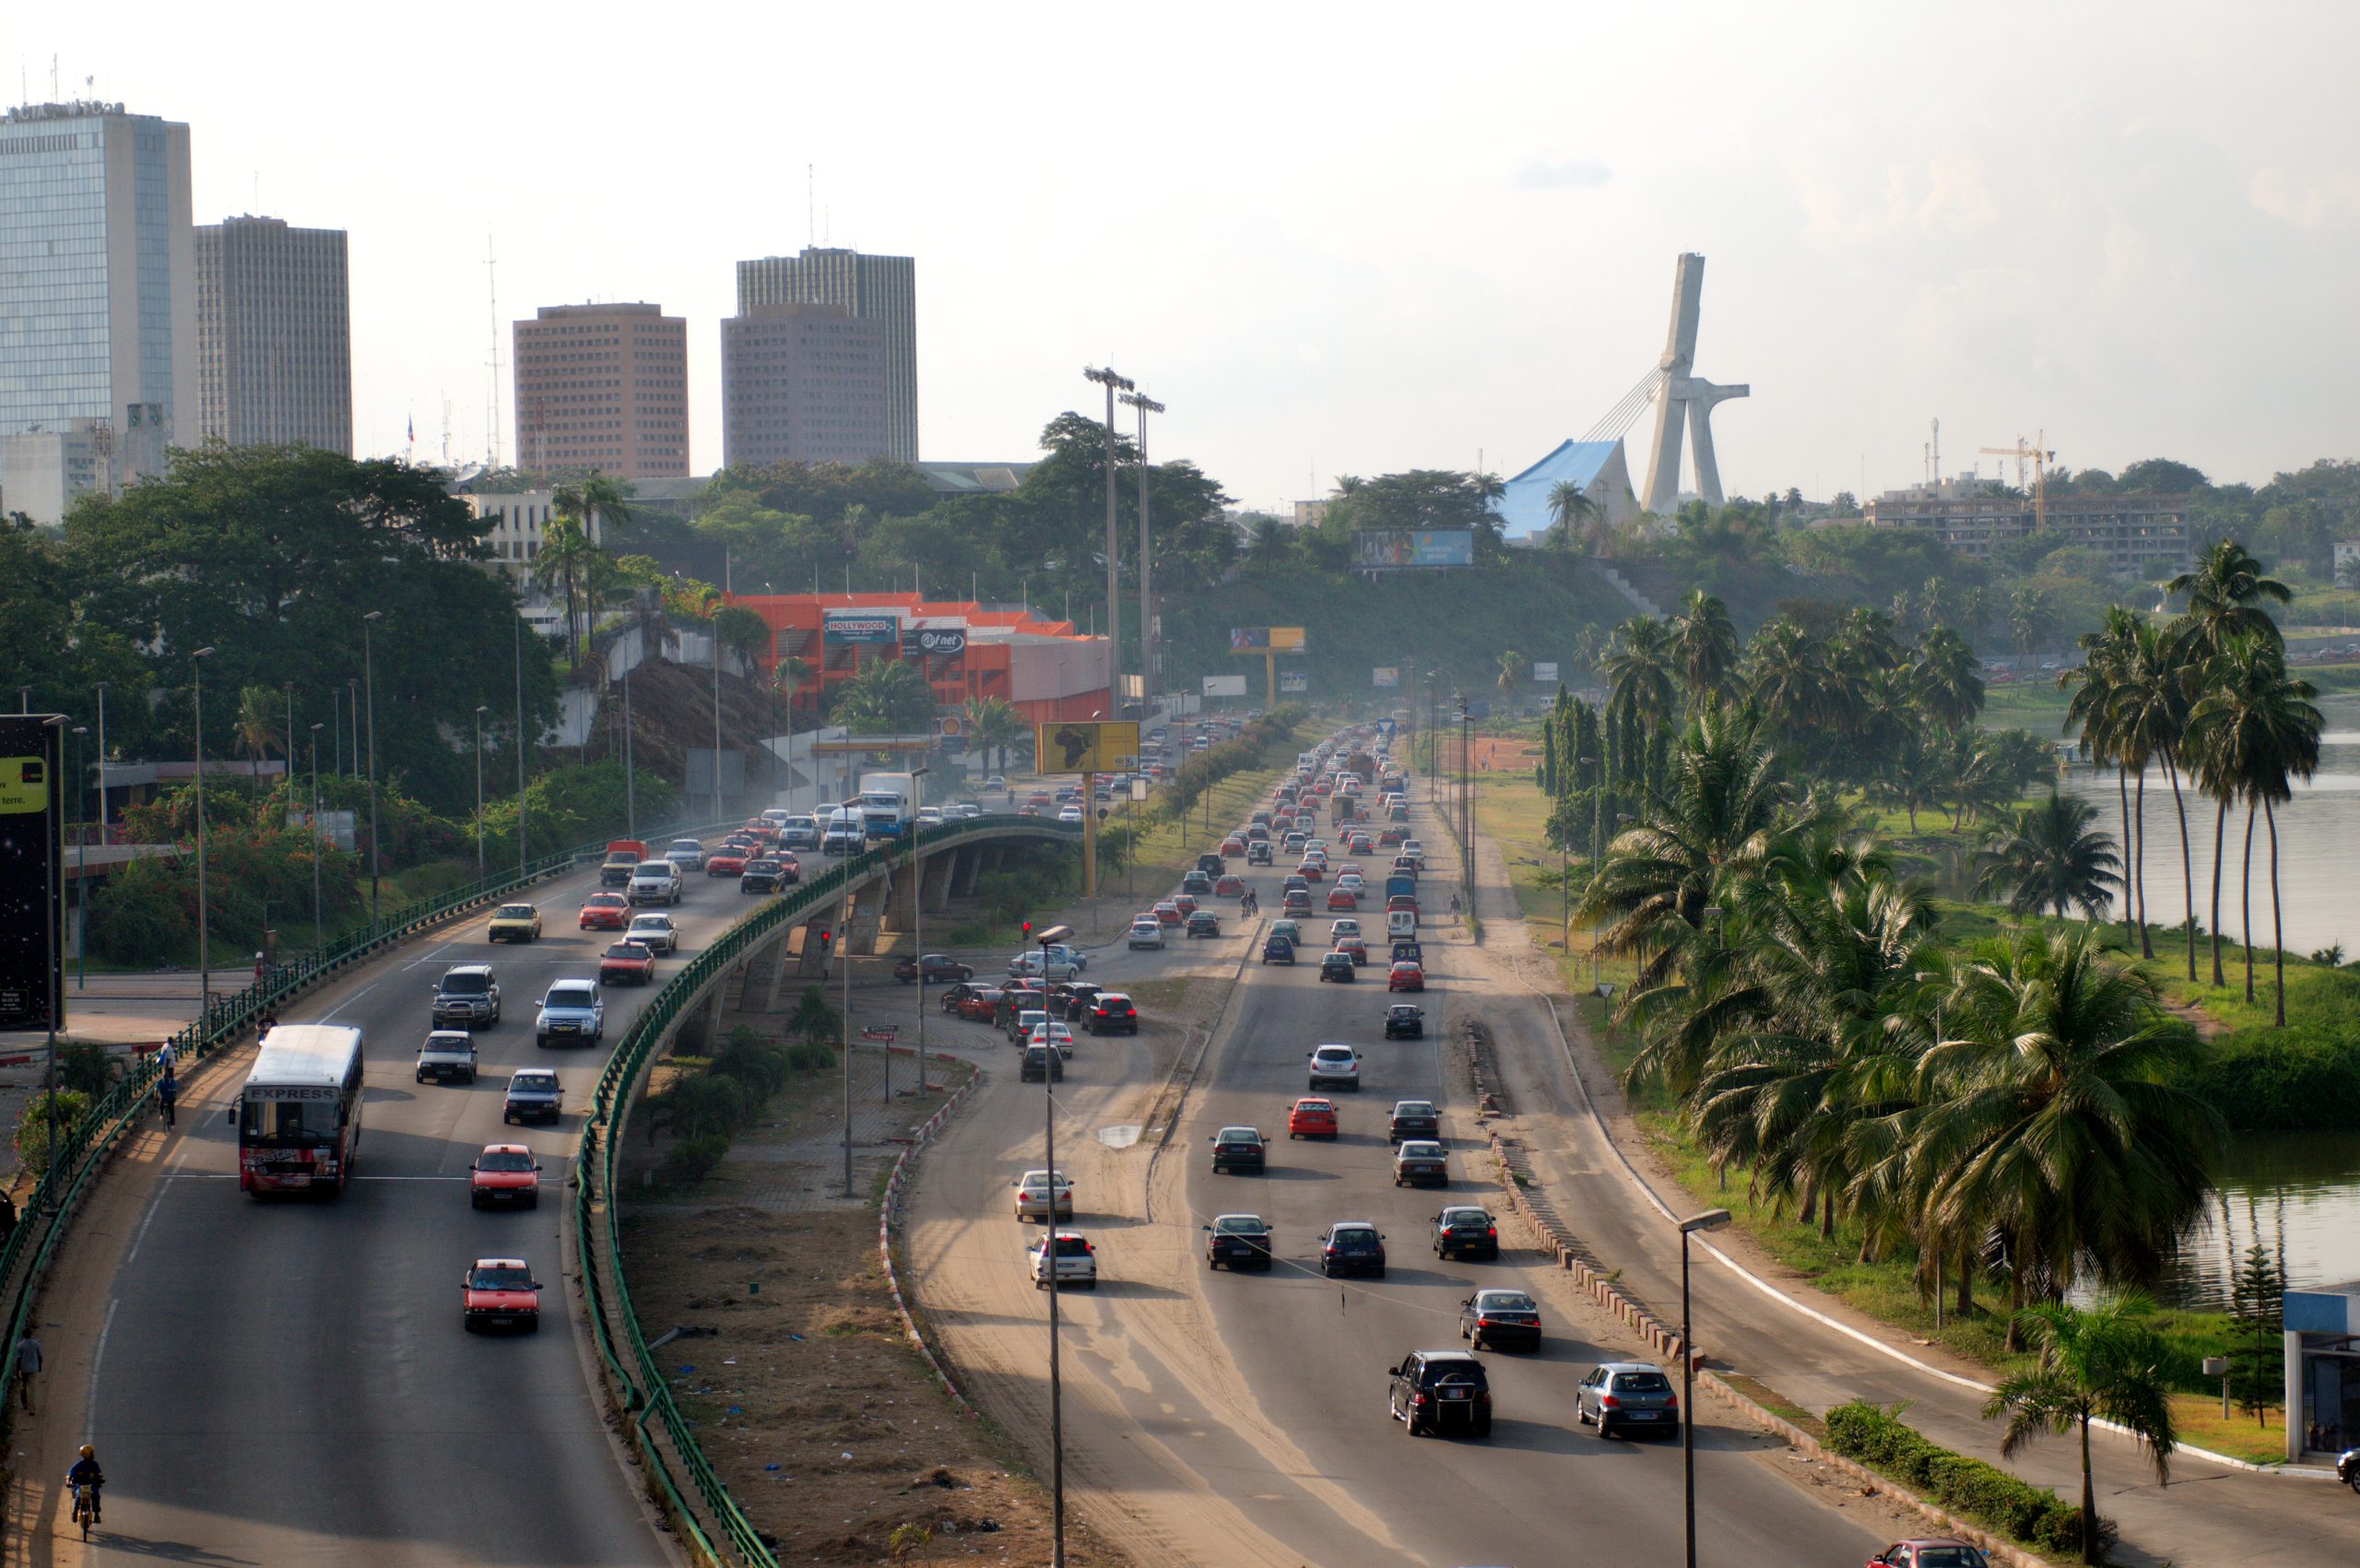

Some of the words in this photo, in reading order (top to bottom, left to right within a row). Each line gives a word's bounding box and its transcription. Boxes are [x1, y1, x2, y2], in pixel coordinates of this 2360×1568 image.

[830, 621, 885, 630] HOLLYWOOD
[2, 796, 26, 805] terre.
[251, 1089, 335, 1100] EXPRESS
